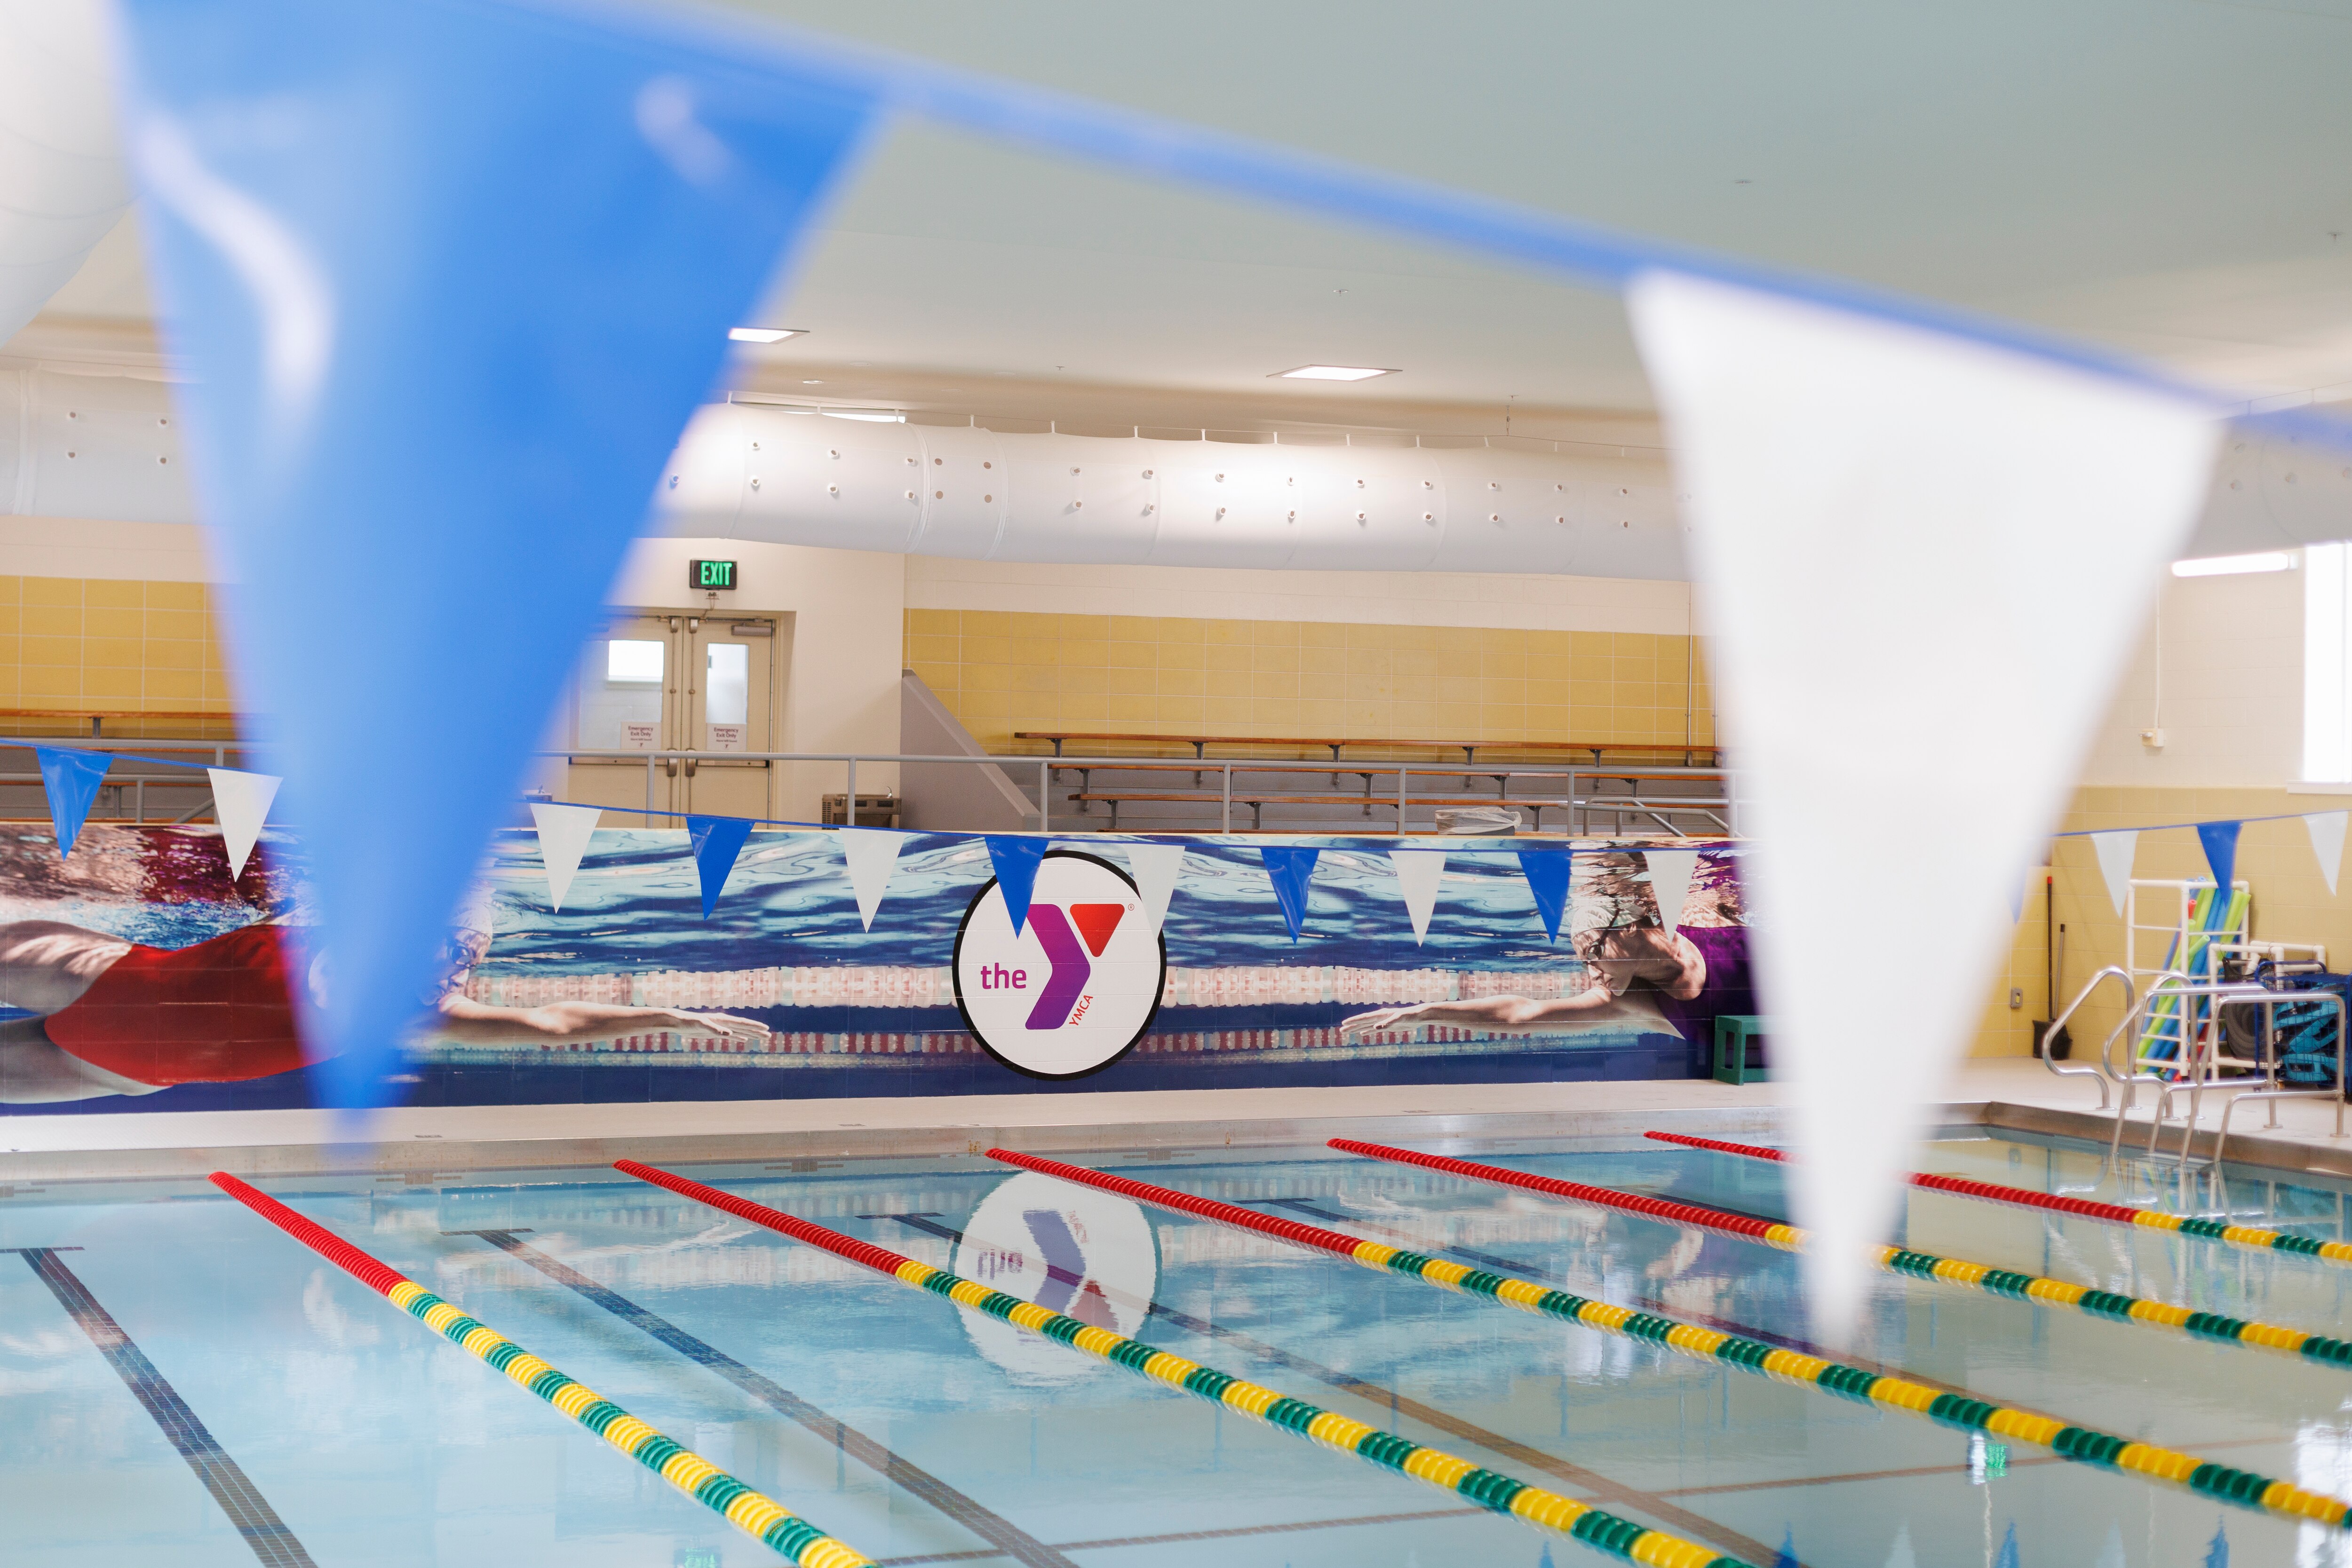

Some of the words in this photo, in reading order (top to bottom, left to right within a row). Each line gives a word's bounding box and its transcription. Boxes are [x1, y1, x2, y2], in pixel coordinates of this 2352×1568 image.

[700, 561, 732, 586] EXIT
[980, 962, 1027, 989] the
[1069, 995, 1093, 1026] YMCA
